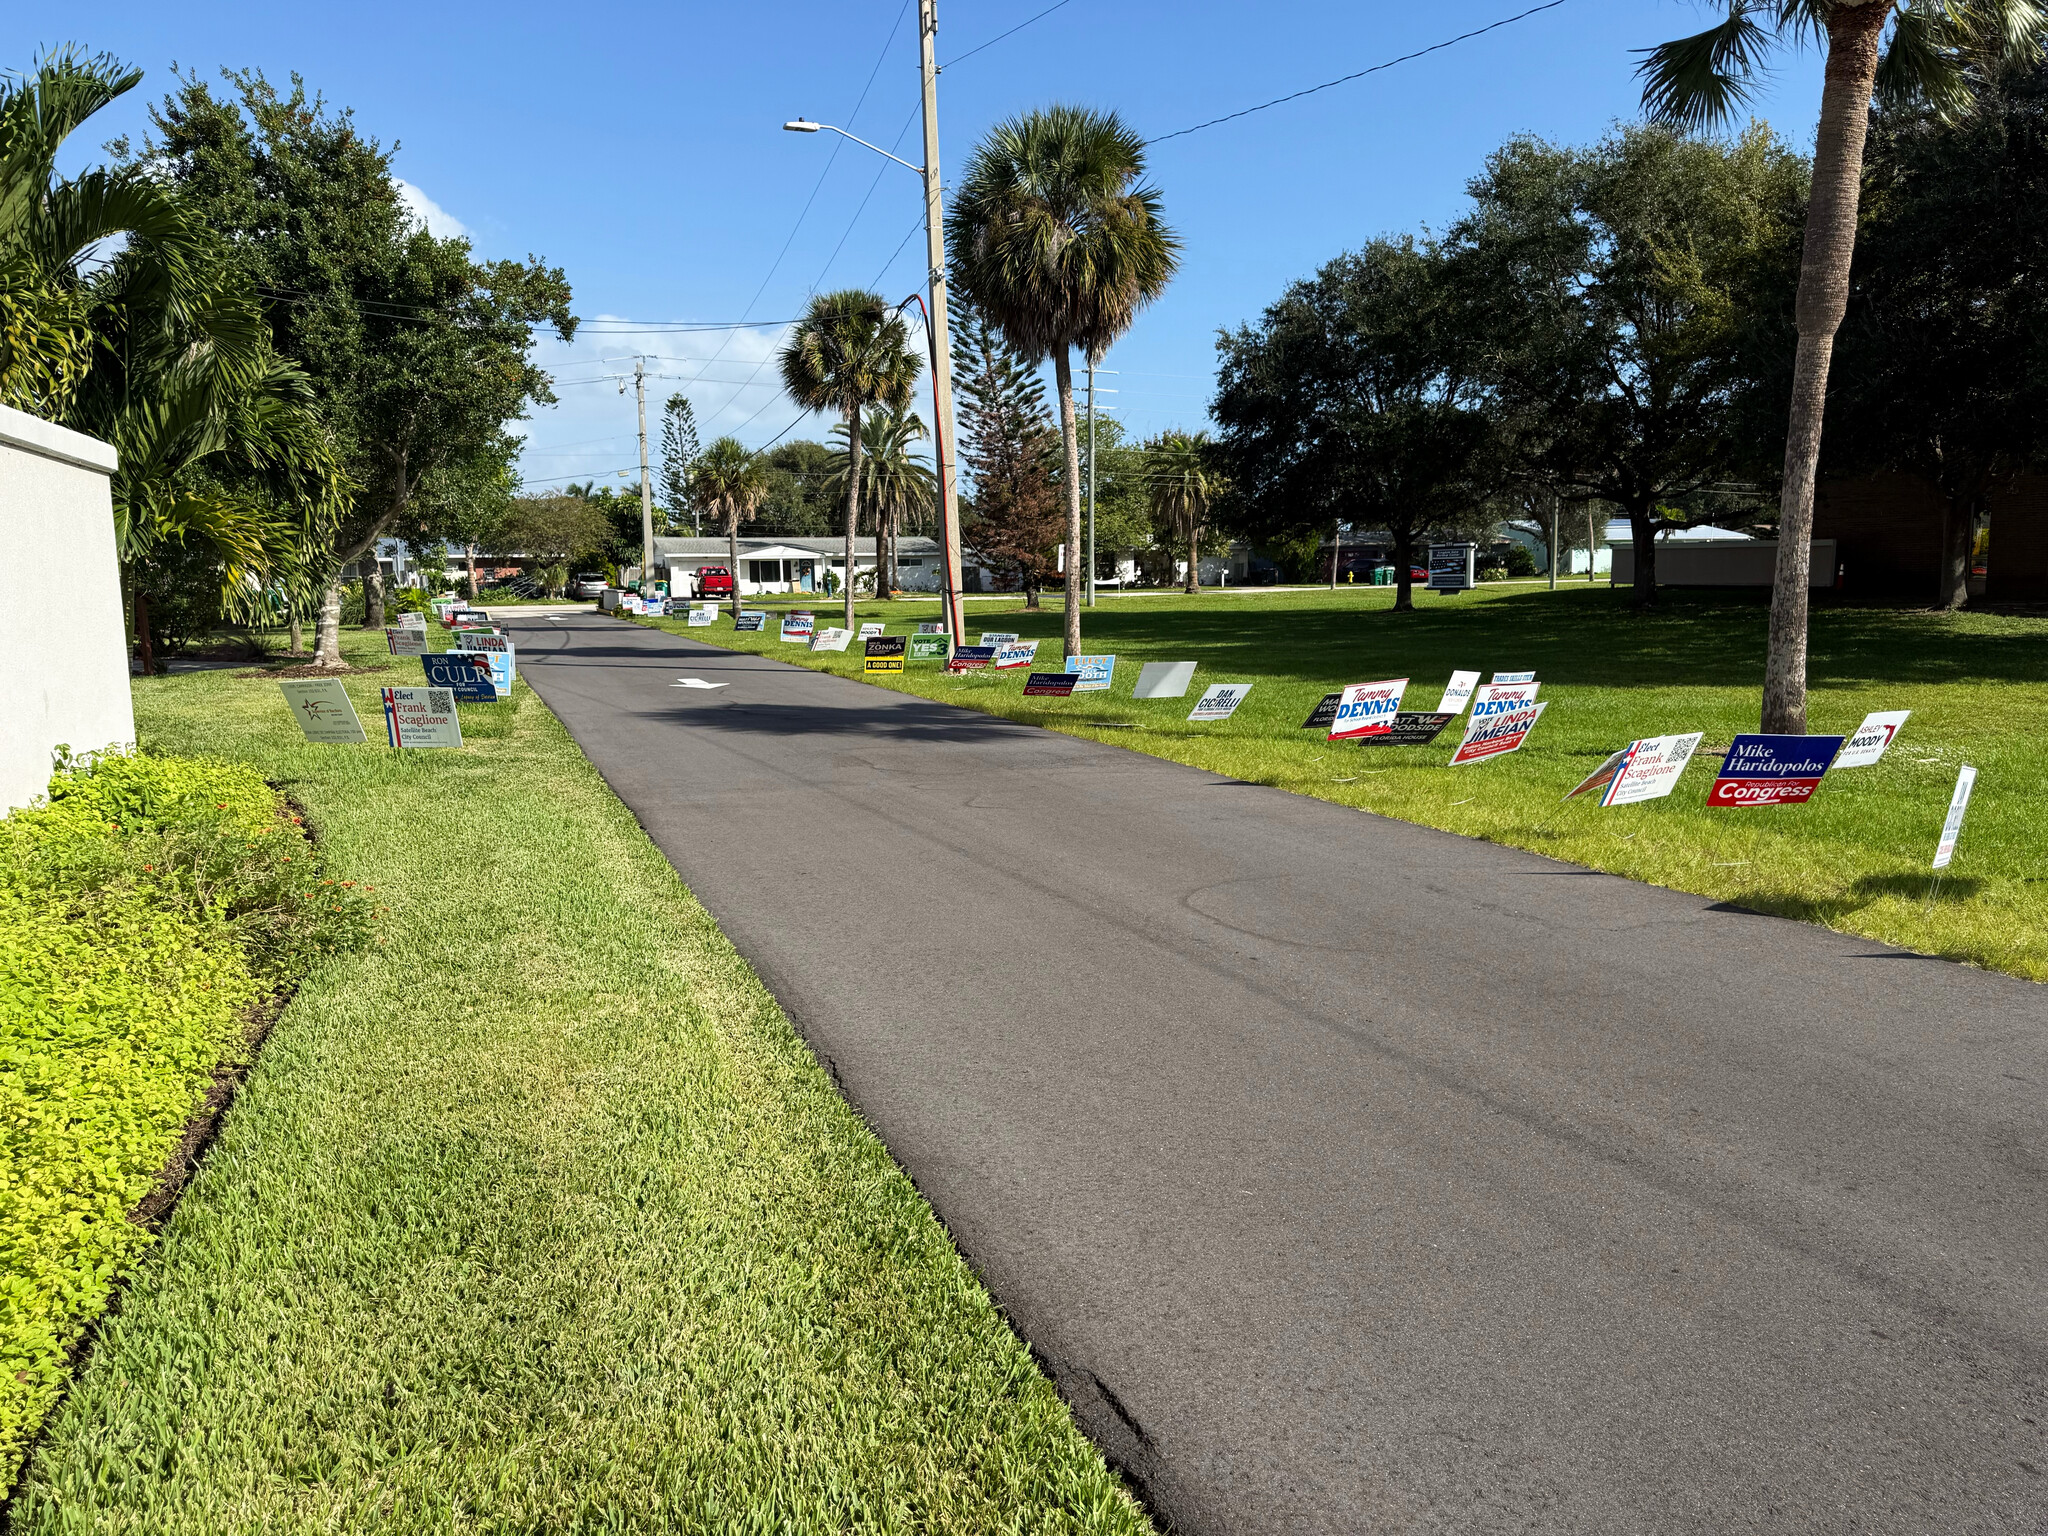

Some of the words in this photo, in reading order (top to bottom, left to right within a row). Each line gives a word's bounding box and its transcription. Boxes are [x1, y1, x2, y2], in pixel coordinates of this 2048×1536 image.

[476, 637, 505, 647] LINDA
[913, 644, 938, 652] YES
[937, 644, 948, 655] 3
[1000, 649, 1035, 660] DENNIS
[951, 660, 987, 668] Congress
[431, 666, 486, 683] CULP
[394, 691, 414, 700] Elect
[1216, 690, 1235, 698] DAN
[1352, 688, 1394, 704] Tammy
[1488, 688, 1526, 704] Tammy
[396, 702, 427, 712] Frank
[1198, 698, 1240, 708] CICIRELLI
[1337, 697, 1400, 719] DENNIS
[1473, 699, 1532, 716] DENNIS
[399, 714, 448, 728] Scaglione
[1493, 709, 1537, 728] LINDA
[1465, 718, 1534, 744] JIMEIAN
[1858, 725, 1883, 734] ASHLEY
[1638, 742, 1660, 753] Elect
[1848, 735, 1884, 748] MOODY
[1733, 744, 1774, 757] Mike
[1631, 753, 1664, 767] Frank
[1727, 758, 1824, 775] Haridopolos
[1625, 765, 1676, 780] Scaglione
[1718, 783, 1812, 800] Congress
